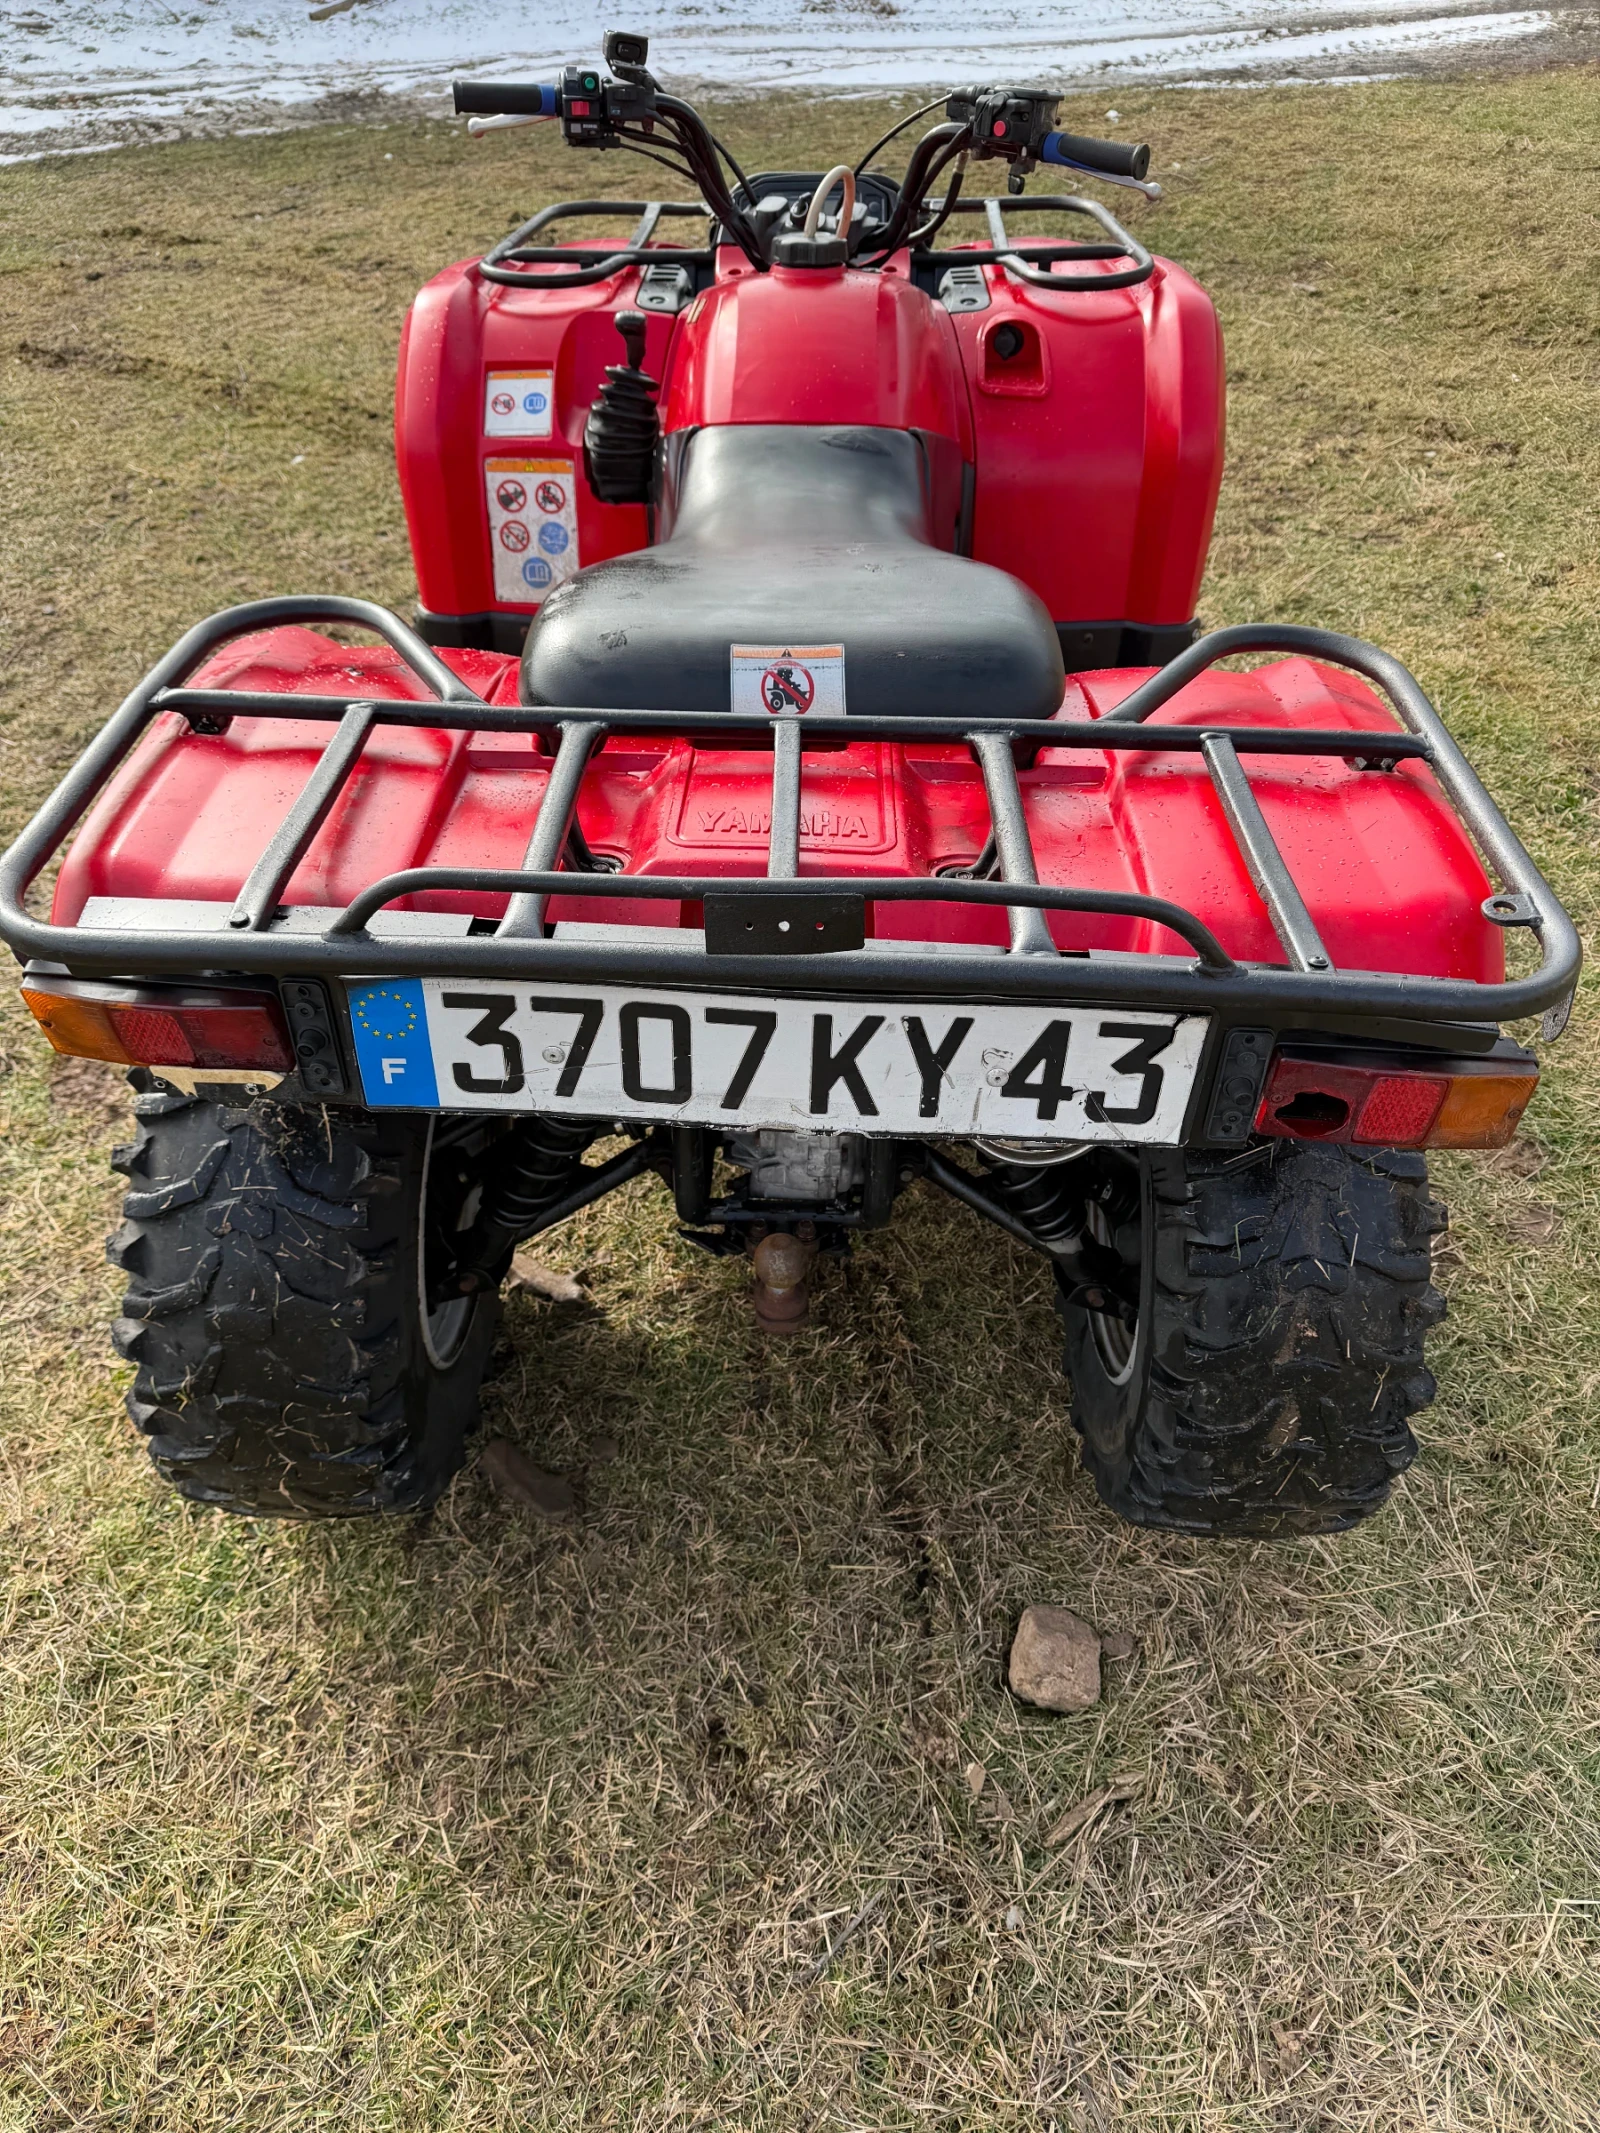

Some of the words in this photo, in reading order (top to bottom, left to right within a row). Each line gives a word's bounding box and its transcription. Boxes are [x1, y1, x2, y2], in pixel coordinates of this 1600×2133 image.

[381, 1058, 407, 1084] F
[442, 991, 778, 1110] 3707
[809, 1013, 975, 1118] KY
[1000, 1019, 1176, 1125] 43
